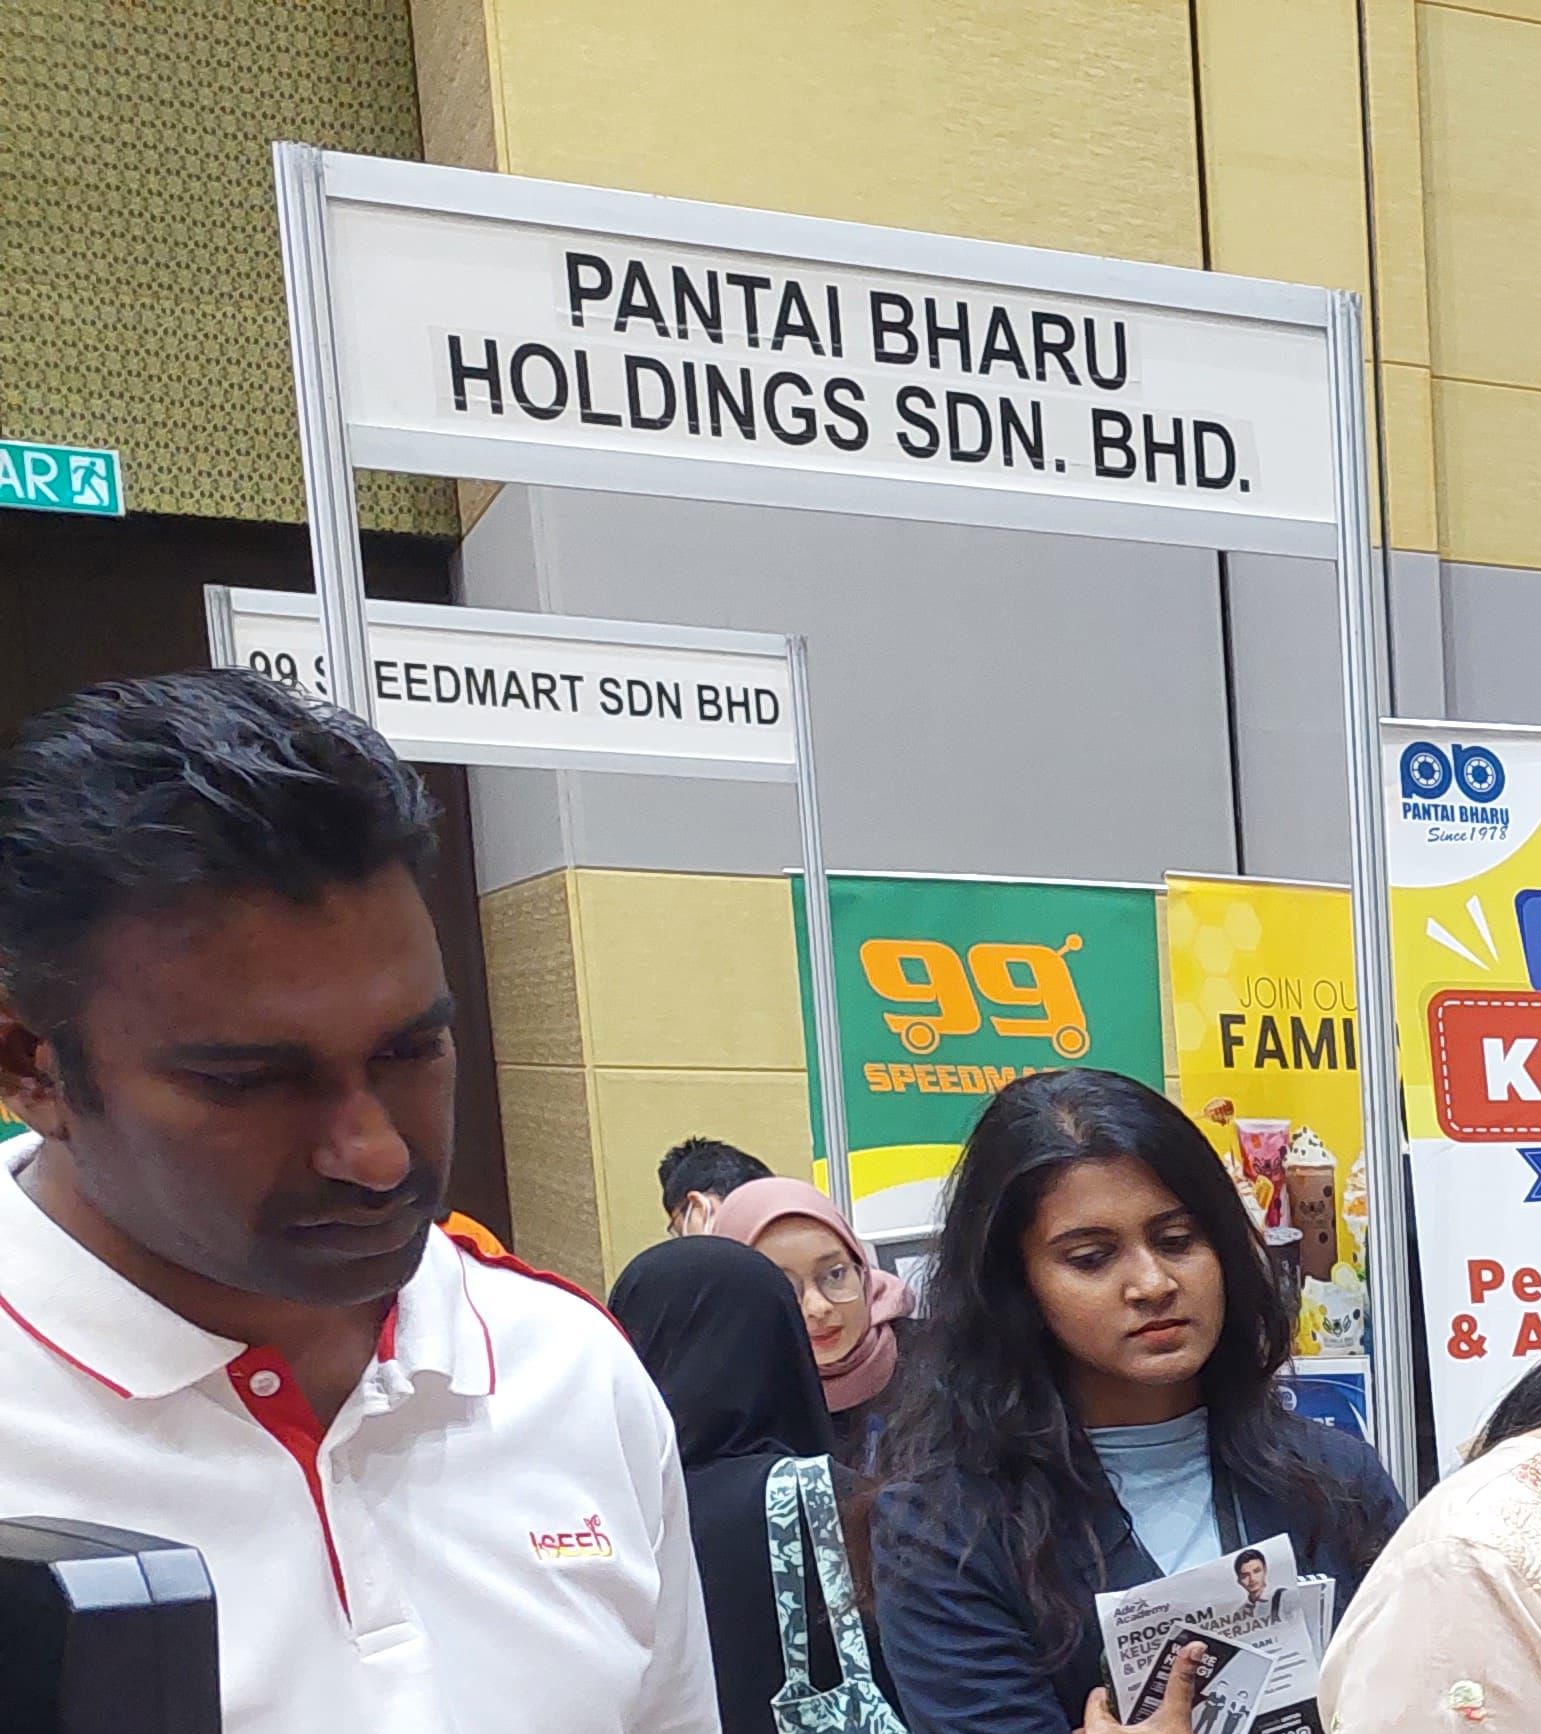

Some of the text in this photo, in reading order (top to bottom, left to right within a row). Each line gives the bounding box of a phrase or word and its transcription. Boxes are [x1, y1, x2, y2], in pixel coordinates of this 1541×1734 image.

[565, 251, 1128, 391] PANTAI BHARU
[446, 333, 1251, 494] HOLDINGS SDN. BHD.
[599, 677, 683, 720] SDN
[697, 684, 780, 725] BHD
[1402, 801, 1510, 826] PANTAI BHARU
[859, 933, 1091, 1060] 99
[1239, 975, 1303, 1011] JOIN
[1218, 1012, 1358, 1071] FAMI
[1446, 1313, 1489, 1360] &
[1117, 1606, 1215, 1650] PROGAM
